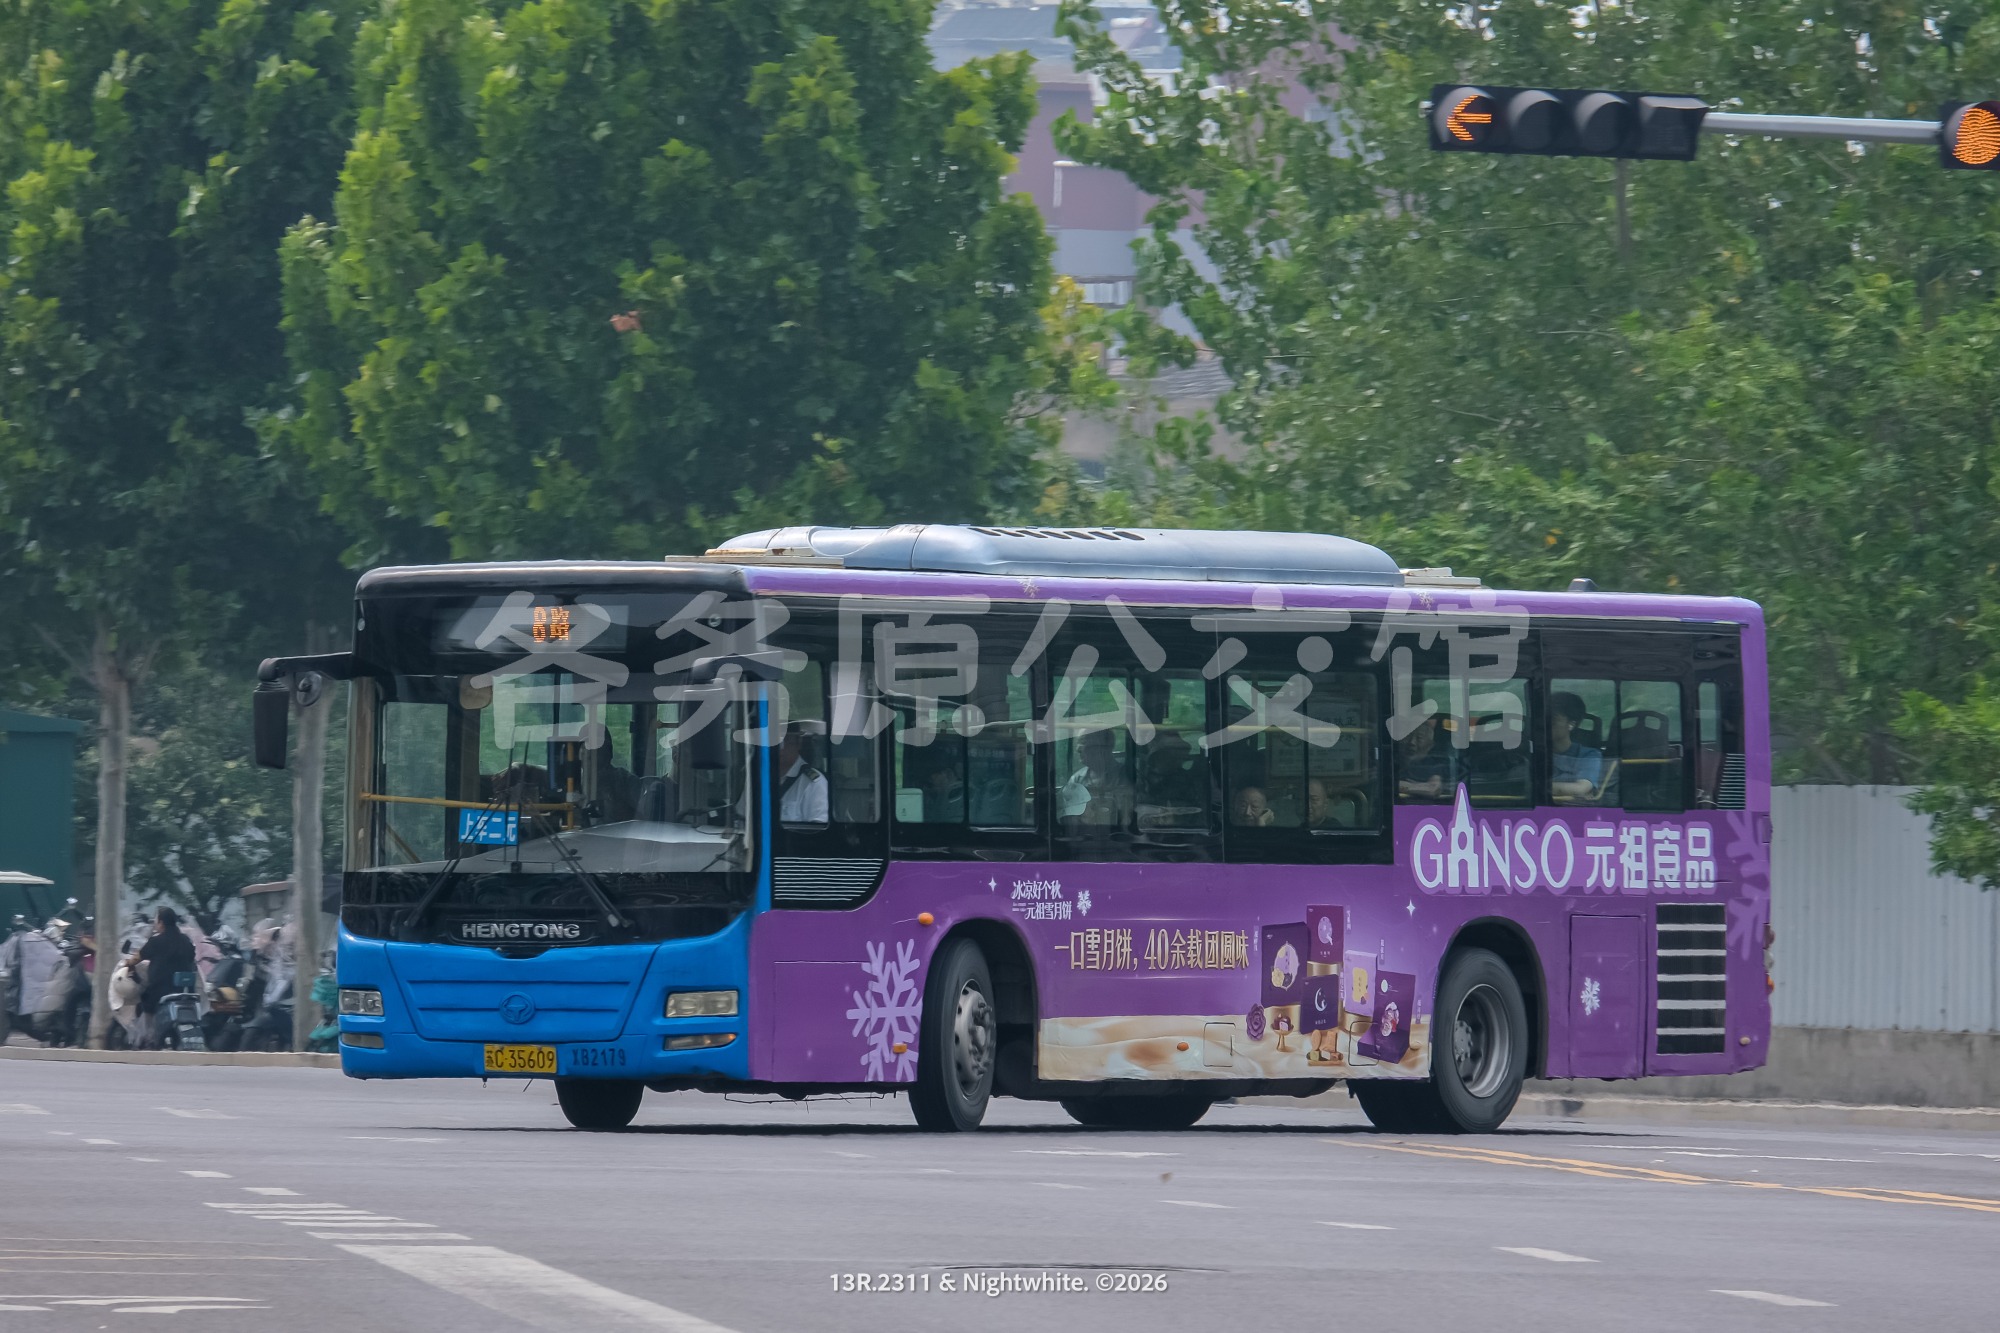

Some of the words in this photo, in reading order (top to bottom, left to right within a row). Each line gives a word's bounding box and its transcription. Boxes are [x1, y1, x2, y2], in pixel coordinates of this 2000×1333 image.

[1413, 788, 1574, 888] GANSO
[1586, 827, 1715, 888] 元祖食品
[1011, 880, 1062, 900] 冰凉好个秋
[1024, 901, 1072, 920] 元祖雪月饼
[462, 923, 580, 938] HENGTONG
[571, 1048, 627, 1066] XB2179
